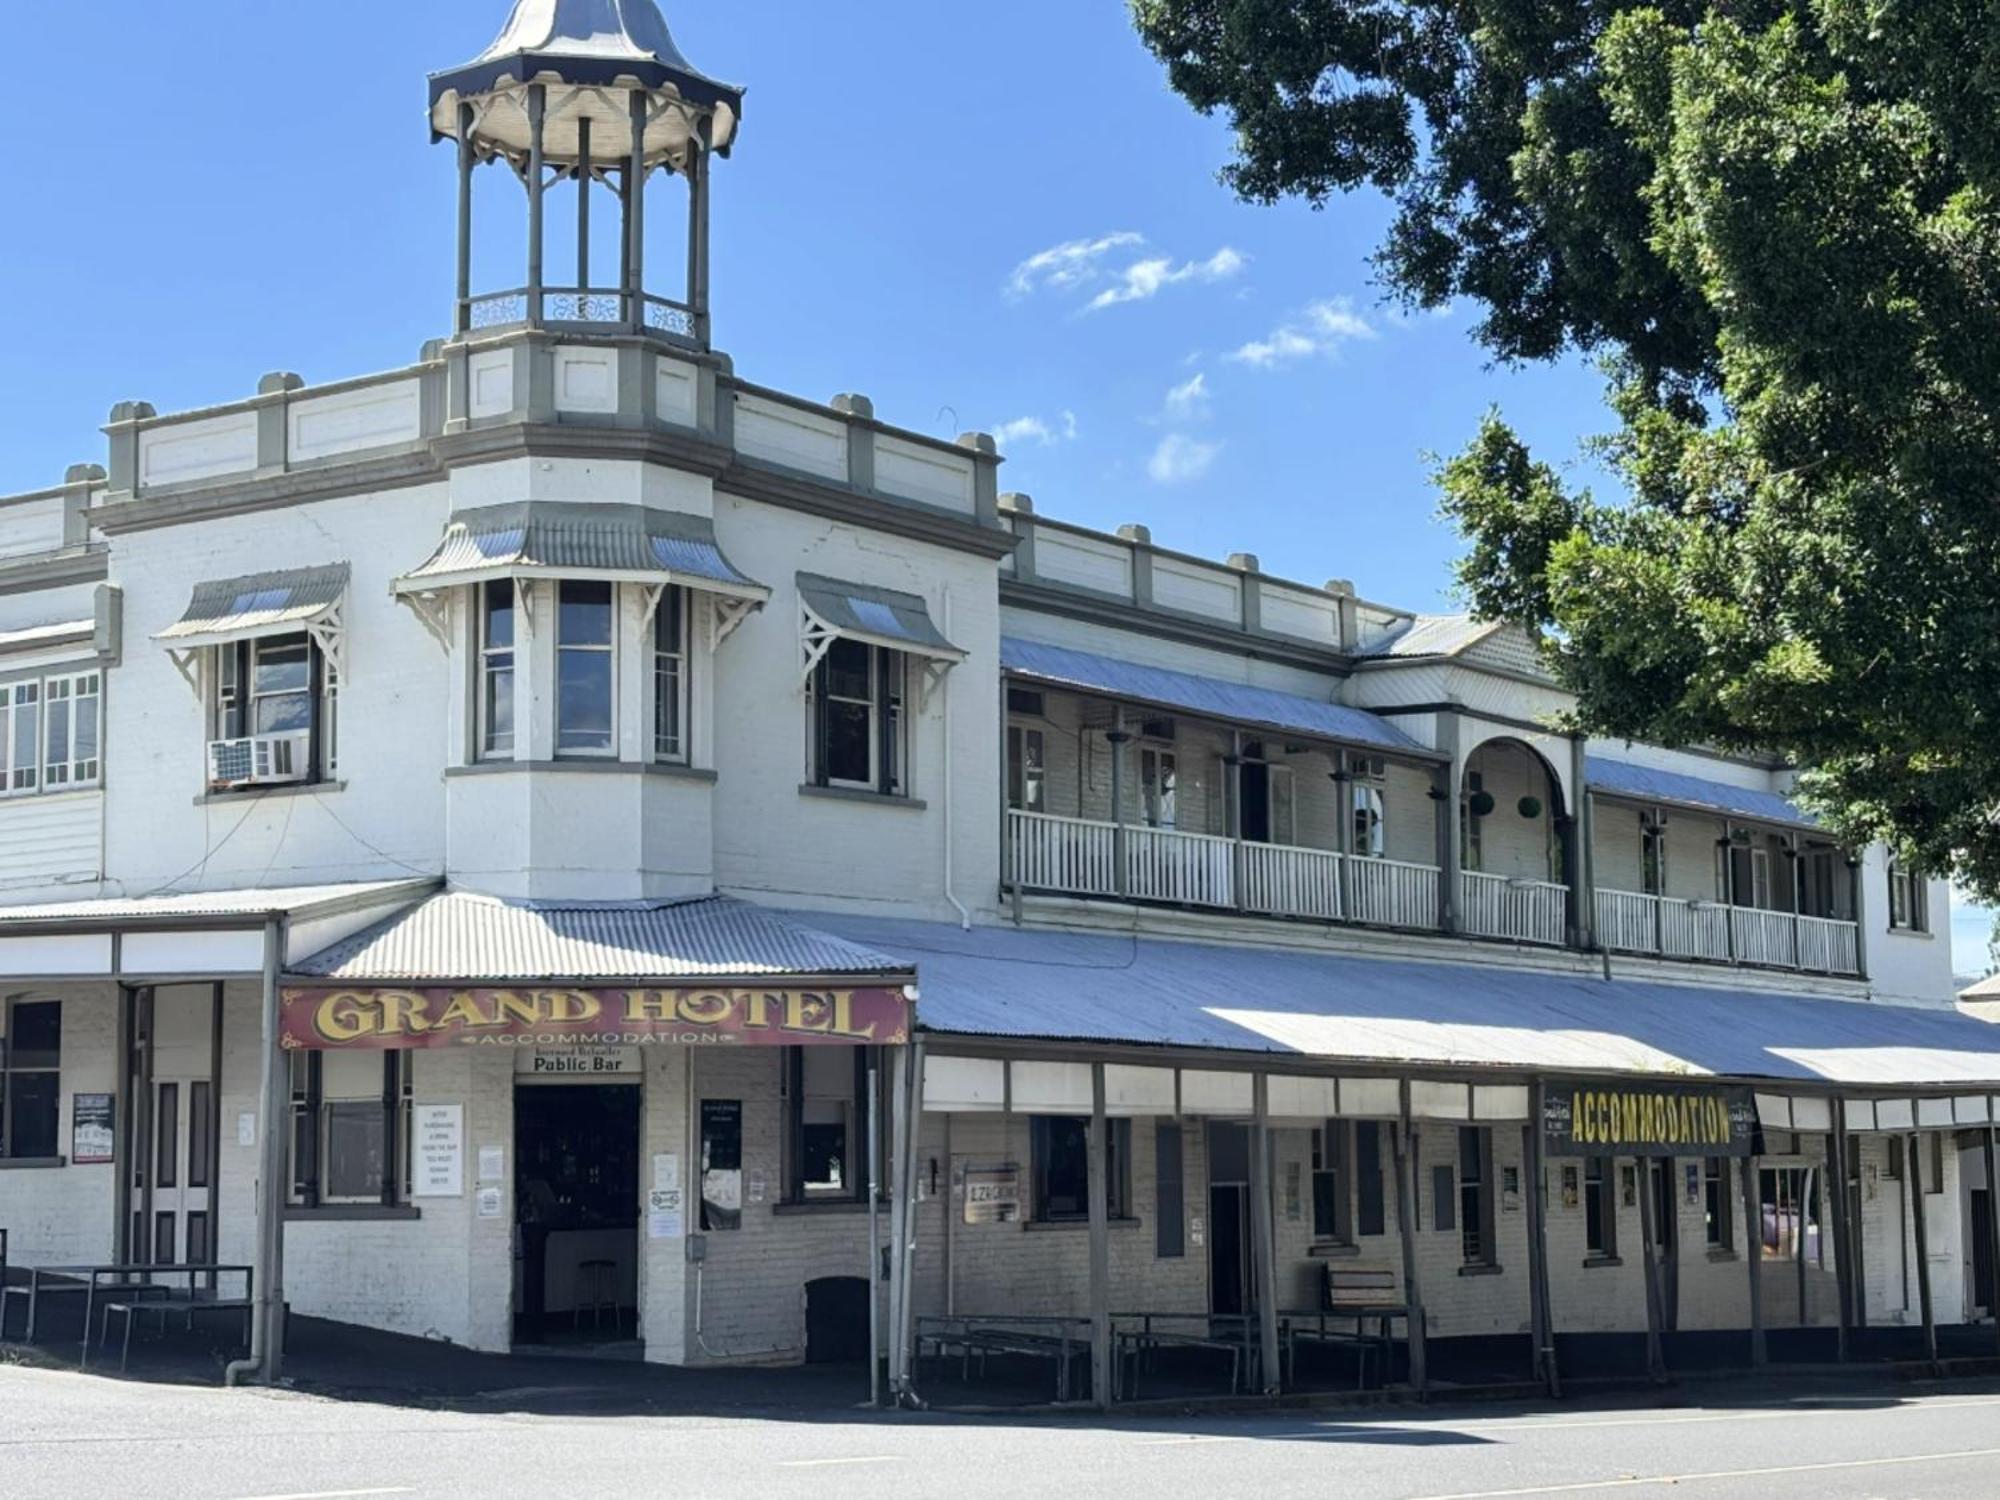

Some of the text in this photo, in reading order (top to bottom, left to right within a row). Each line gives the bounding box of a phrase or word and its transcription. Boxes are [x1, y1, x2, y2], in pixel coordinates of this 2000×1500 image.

[315, 990, 874, 1041] GRAND HOTEL
[480, 1033, 718, 1045] ACCOMMODATION
[533, 1057, 622, 1071] Public Bar
[1572, 1091, 1730, 1143] ACCOMMODATION
